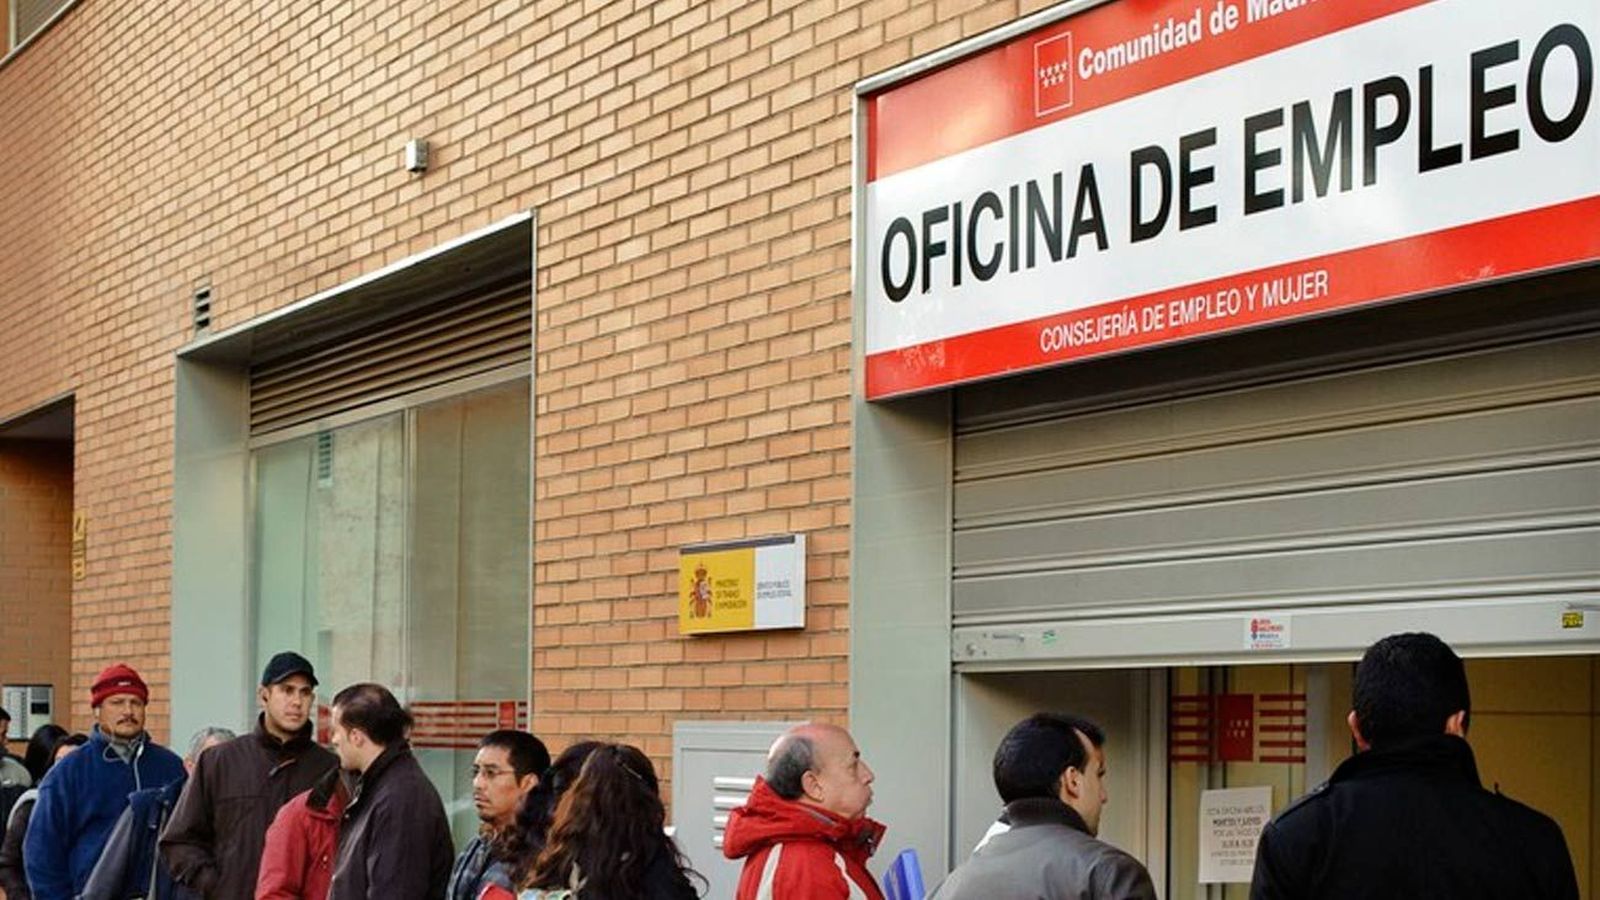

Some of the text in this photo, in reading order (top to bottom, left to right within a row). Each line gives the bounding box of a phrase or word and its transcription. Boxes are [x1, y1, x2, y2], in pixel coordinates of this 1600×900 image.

[1078, 8, 1202, 80] Comunidad
[1209, 1, 1240, 36] de
[881, 23, 1593, 303] OFICINA DE EMPLEO
[1040, 269, 1329, 353] CONSEJERÍA DE EMPLEO Y MUJER
